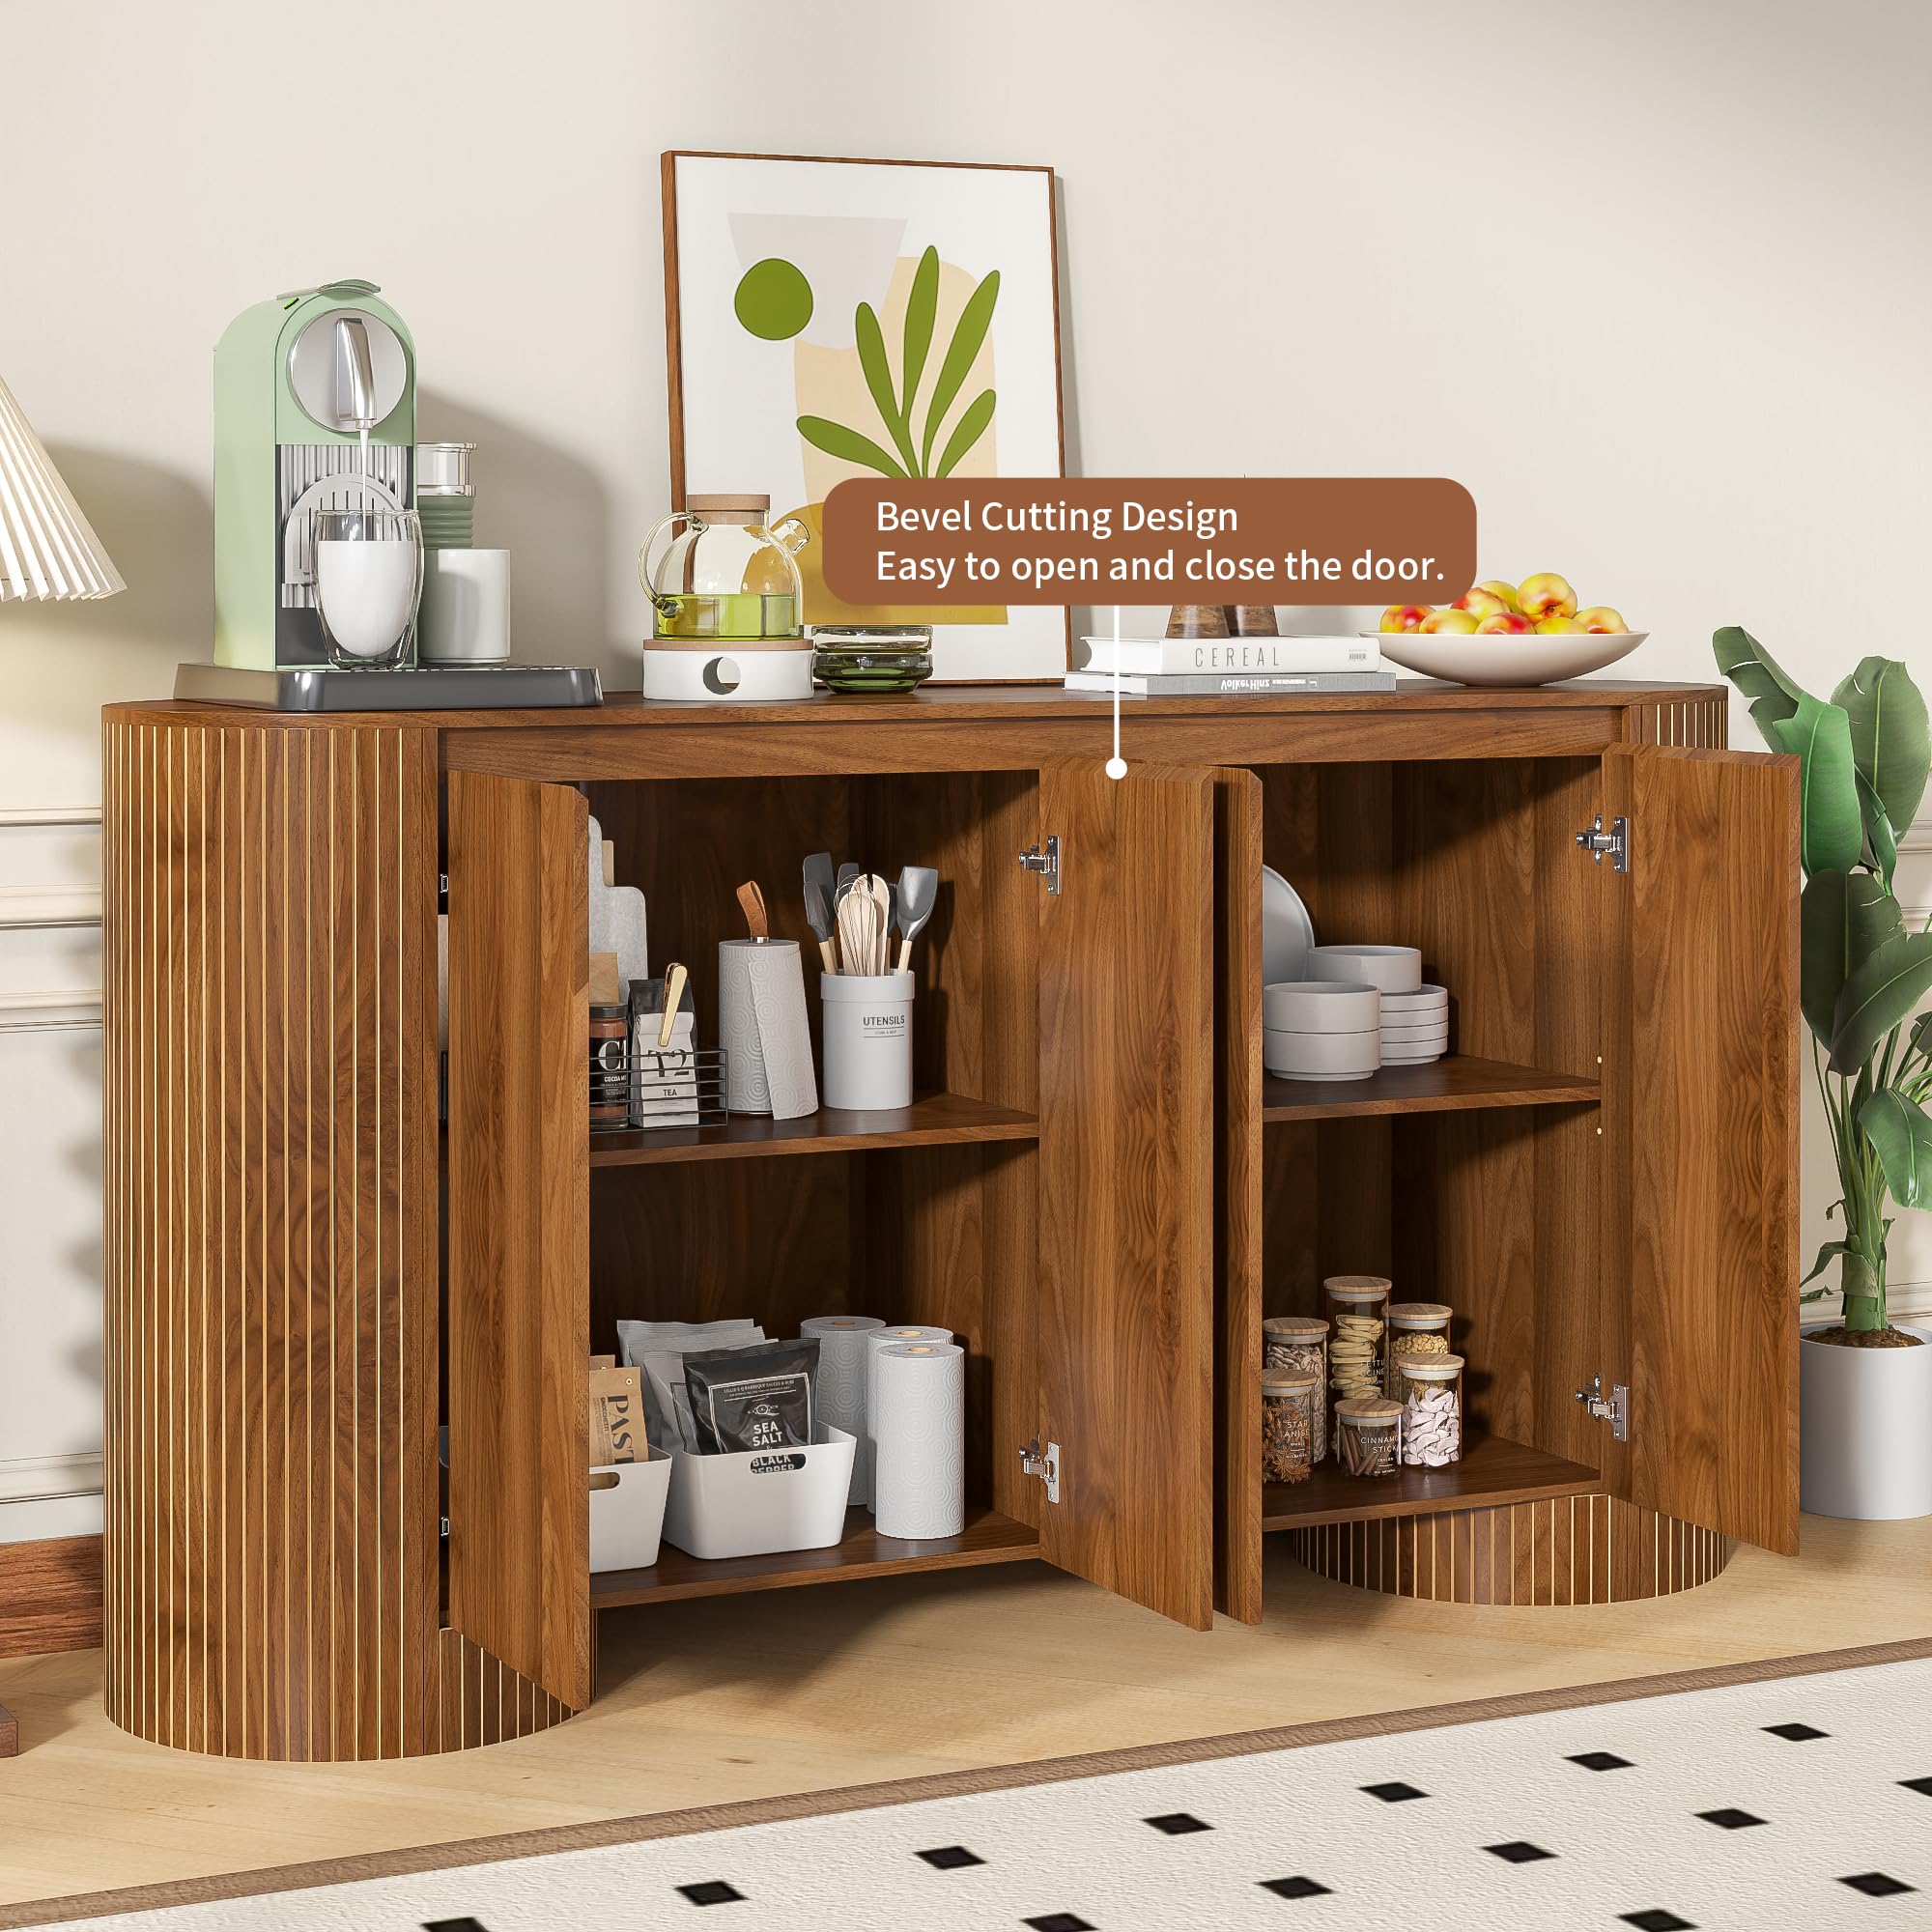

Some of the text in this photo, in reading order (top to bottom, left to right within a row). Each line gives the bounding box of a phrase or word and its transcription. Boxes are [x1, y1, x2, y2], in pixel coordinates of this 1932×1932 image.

[1195, 647, 1280, 668] CEREAL
[863, 1015, 905, 1026] UTENSILS
[663, 1089, 678, 1097] TEA
[607, 1394, 635, 1464] PAST
[753, 1420, 779, 1435] SEA
[1287, 1419, 1308, 1429] STAR
[752, 1432, 782, 1447] SALT
[752, 1454, 792, 1467] BLACK
